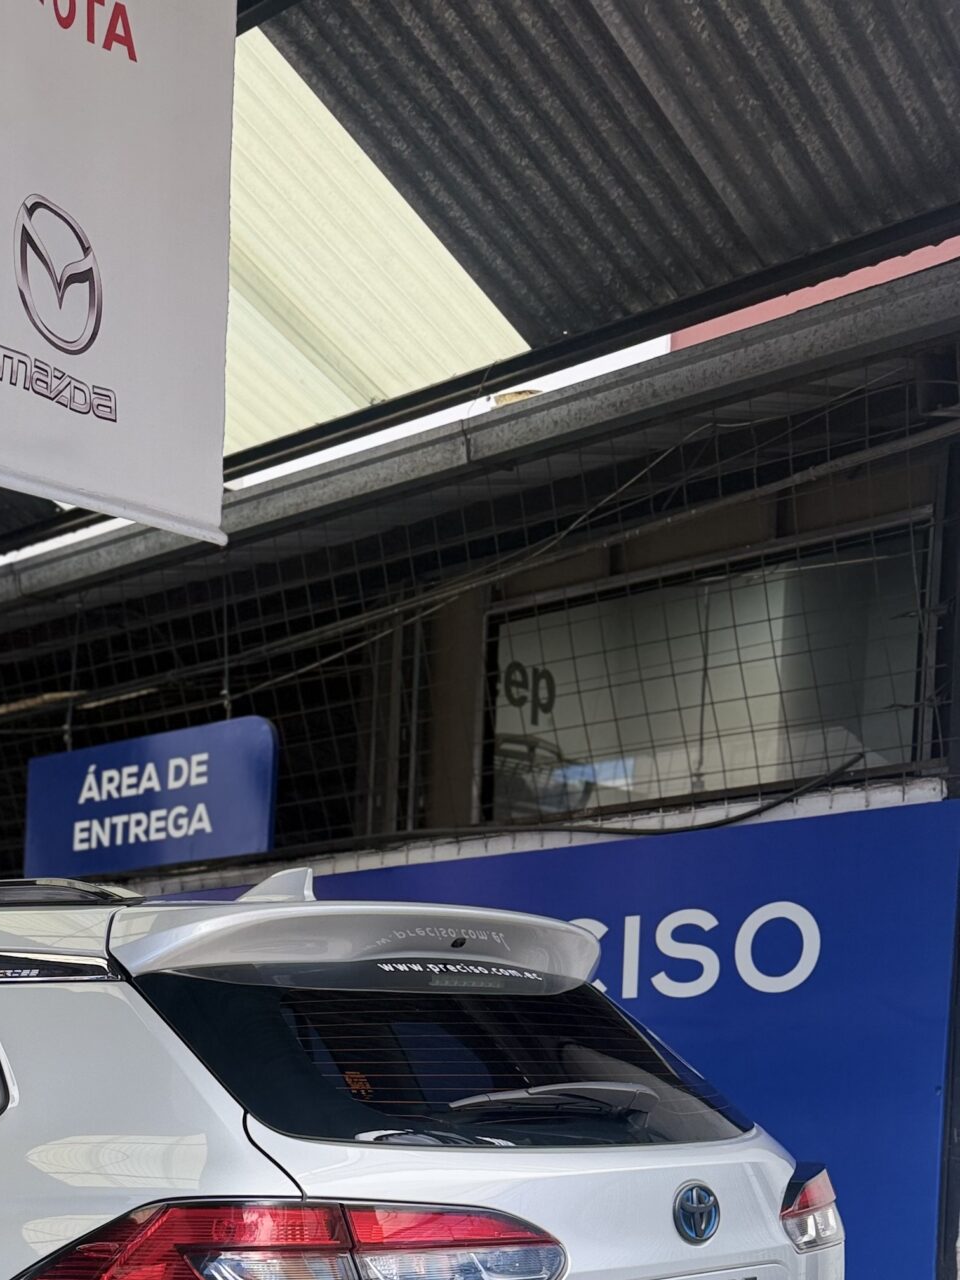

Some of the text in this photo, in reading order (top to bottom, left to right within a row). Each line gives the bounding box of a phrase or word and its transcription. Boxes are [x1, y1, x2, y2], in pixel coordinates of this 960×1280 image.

[38, 0, 137, 63] OTA
[497, 661, 556, 726] ep
[77, 752, 209, 804] ÁREA DE
[73, 803, 212, 851] ENTREGA
[377, 962, 543, 982] www.preciso.com.ec
